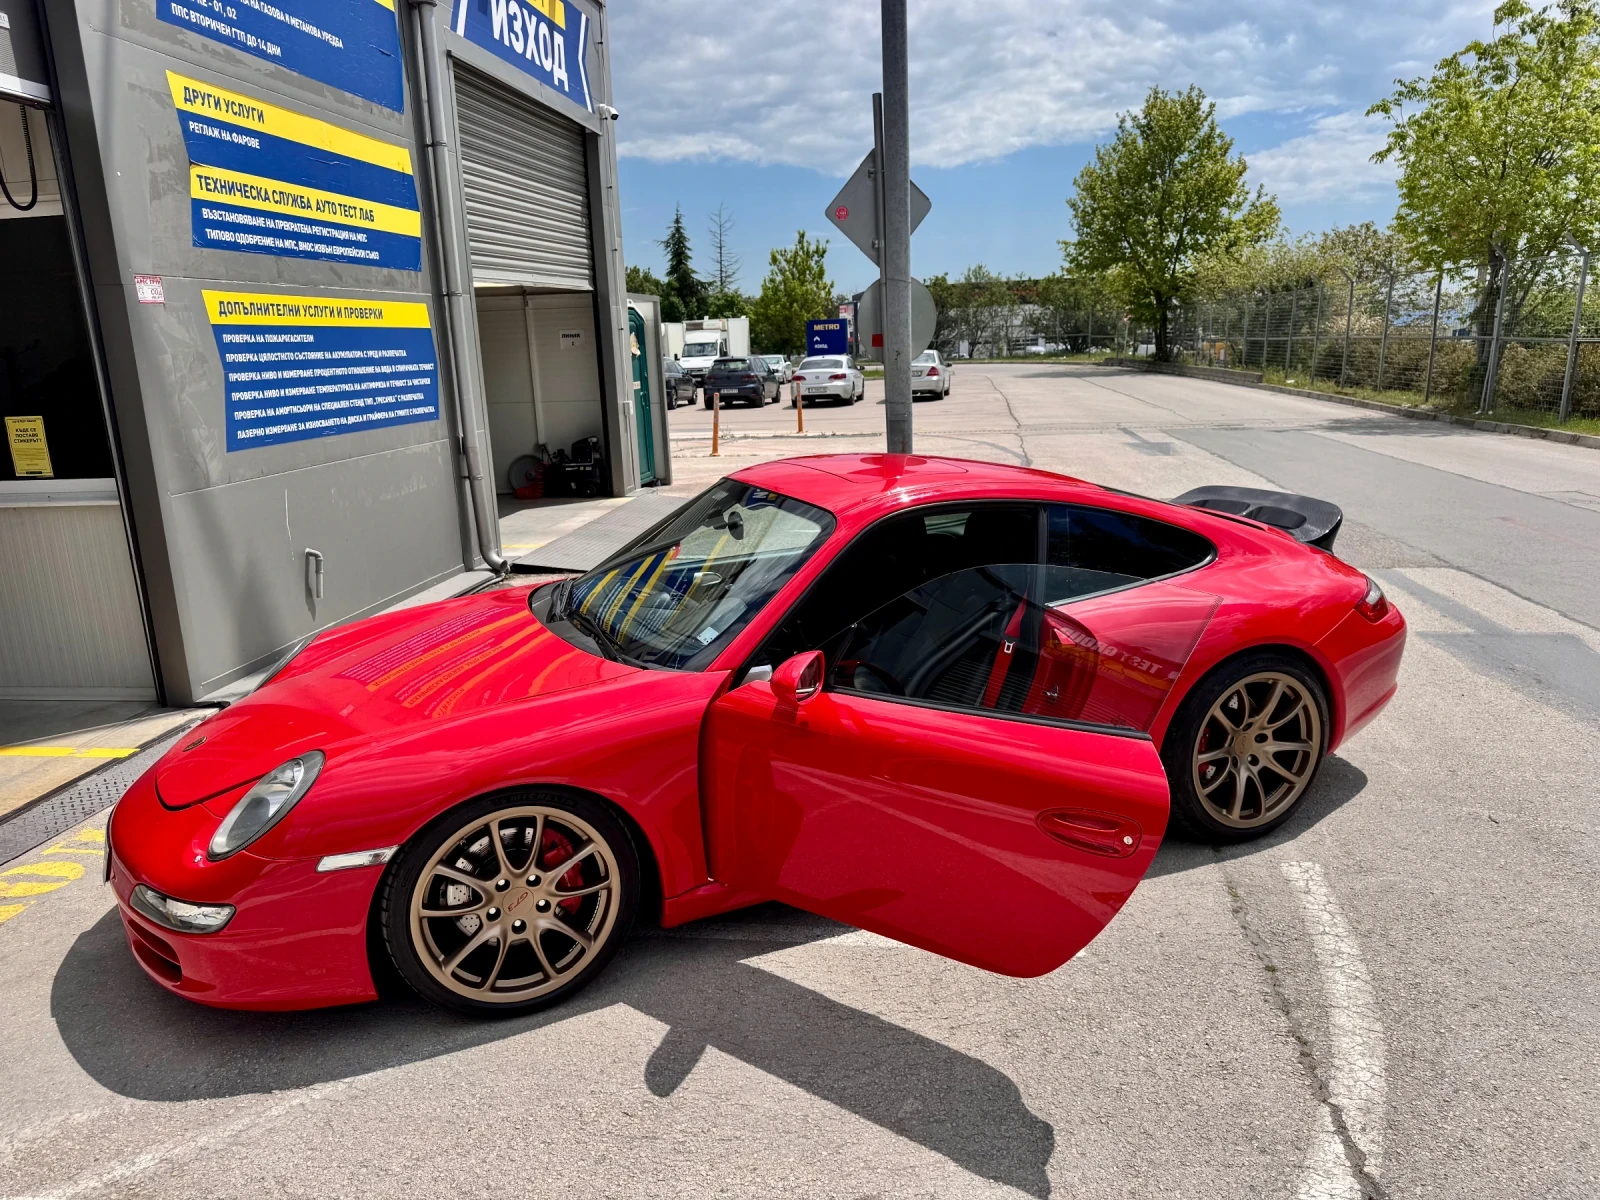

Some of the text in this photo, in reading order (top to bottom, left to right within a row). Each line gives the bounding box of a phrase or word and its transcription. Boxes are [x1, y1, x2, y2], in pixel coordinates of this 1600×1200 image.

[226, 6, 237, 20] 02
[261, 2, 285, 22] ГАЗОВА
[290, 16, 321, 39] МЕТАНОВА
[321, 30, 344, 49] УРЕДБА
[171, 2, 189, 20] ППС
[190, 10, 231, 37] ВТОРИЧЕН
[232, 27, 246, 42] ГТП
[247, 34, 257, 48] ДО
[258, 38, 266, 50] 14
[266, 42, 282, 57] ДНИ
[490, 0, 569, 92] ИЗХОД
[184, 85, 265, 124] ДРУГИ УСЛУГИ
[188, 120, 260, 149] РЕГЛАЖ НА ФАРОВЕ
[196, 174, 374, 222] ТЕХНИЧЕСКА СЛУЖБА АУТО ТЕСТ ЛАБ
[202, 208, 367, 242] ВЪЗСТАНОВЯВАНЕ НА ПРЕКРАТЕНА РЕГИСТРАЦИЯ НА МПС
[205, 228, 379, 260] ТИПОВО ОДОБРЕНИЕ НА МПС, ВНОС ИЗВЪН ЕВРОПЕЙСКИ СЪЮЗ
[218, 300, 383, 320] ДОПЪЛНИТЕЛНИ УСЛУГИ И ПРОВЕРКИ
[223, 334, 255, 343] ПРОВЕРКА
[256, 334, 264, 343] НА
[226, 352, 258, 362] ПРОВЕРКА
[295, 351, 324, 360] СЪСТОЯНИЕ
[325, 351, 332, 359] НА
[367, 350, 378, 358] УРЕД
[229, 371, 261, 382] ПРОВЕРКА
[262, 371, 277, 380] НИВО
[283, 369, 313, 378] ИЗМЕРВАНЕ
[314, 367, 347, 377] ПРОЦЕНТНОТО
[232, 390, 264, 401] ПРОВЕРКА
[264, 389, 280, 398] НИВО
[285, 386, 316, 397] ИЗМЕРВАНЕ
[316, 383, 354, 393] ТЕМПЕРАТУРАТА
[234, 409, 266, 420] ПРОВЕРКА
[267, 408, 275, 416] НА
[276, 404, 313, 415] АМОРТИСЬОРИ
[314, 402, 321, 411] НА
[321, 400, 349, 410] СПЕЦИАЛЕН
[350, 399, 364, 408] СТЕНД
[238, 428, 264, 439] ЛАЗЕРНО
[265, 423, 298, 435] ИЗМЕРВАНЕ
[298, 422, 306, 430] ЗА
[306, 417, 340, 430] ИЗНОСВАНЕТО
[340, 416, 348, 425] НА
[348, 415, 362, 425] ДИСКА
